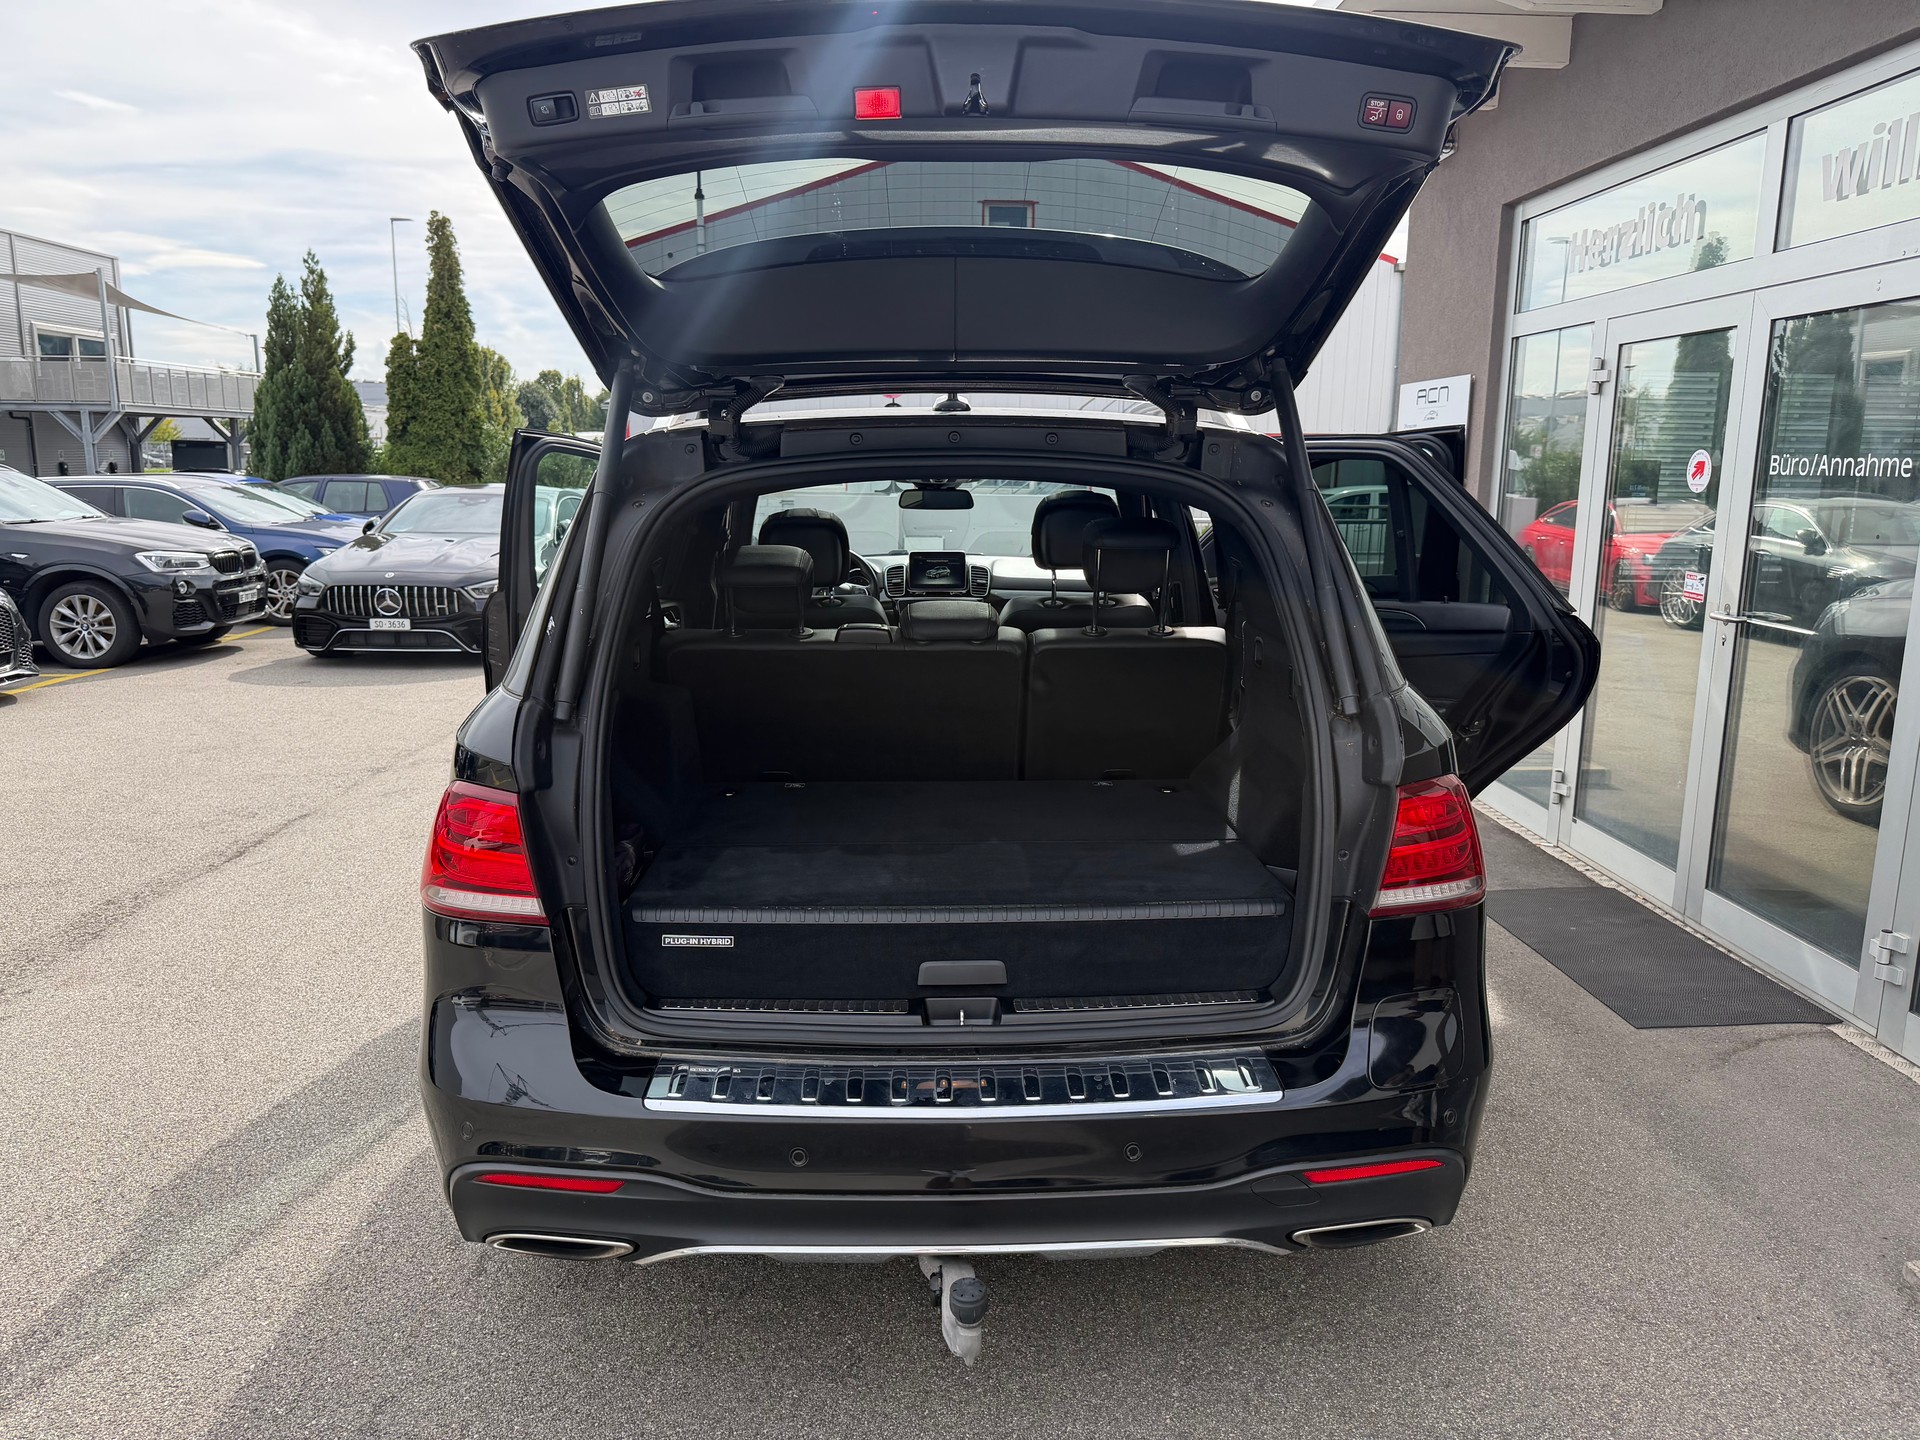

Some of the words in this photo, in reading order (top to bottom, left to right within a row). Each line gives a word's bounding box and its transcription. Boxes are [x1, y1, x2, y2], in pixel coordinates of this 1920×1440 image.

[1569, 193, 1704, 273] Herzlich
[1769, 453, 1913, 478] Büro/Annahme
[665, 937, 698, 945] PLUG-IN
